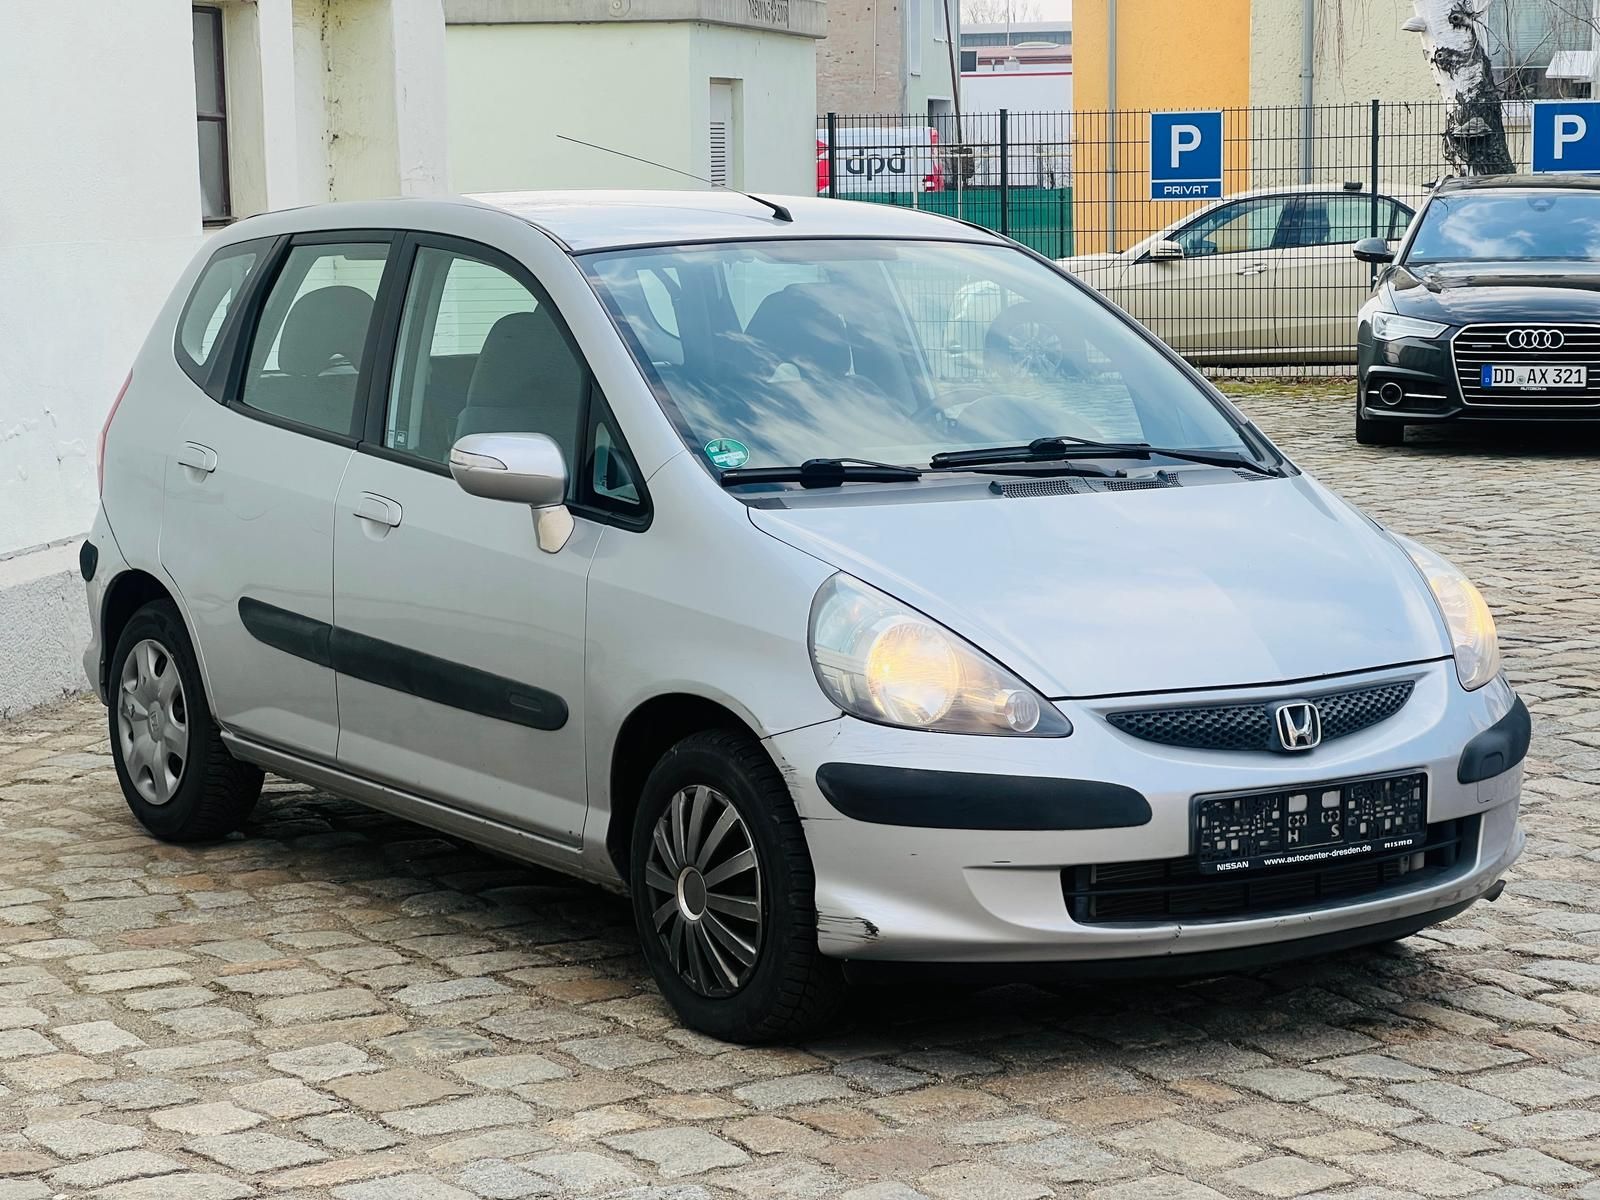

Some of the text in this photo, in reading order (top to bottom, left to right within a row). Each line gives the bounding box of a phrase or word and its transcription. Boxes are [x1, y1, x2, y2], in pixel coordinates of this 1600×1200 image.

[1171, 124, 1202, 168] P
[1553, 114, 1587, 160] P
[845, 146, 906, 181] dpd
[1163, 185, 1209, 195] PRIVAT
[1493, 368, 1584, 384] DD AX 321
[1216, 838, 1413, 872] NISSAN www.autocenter-dresden.de nismo
